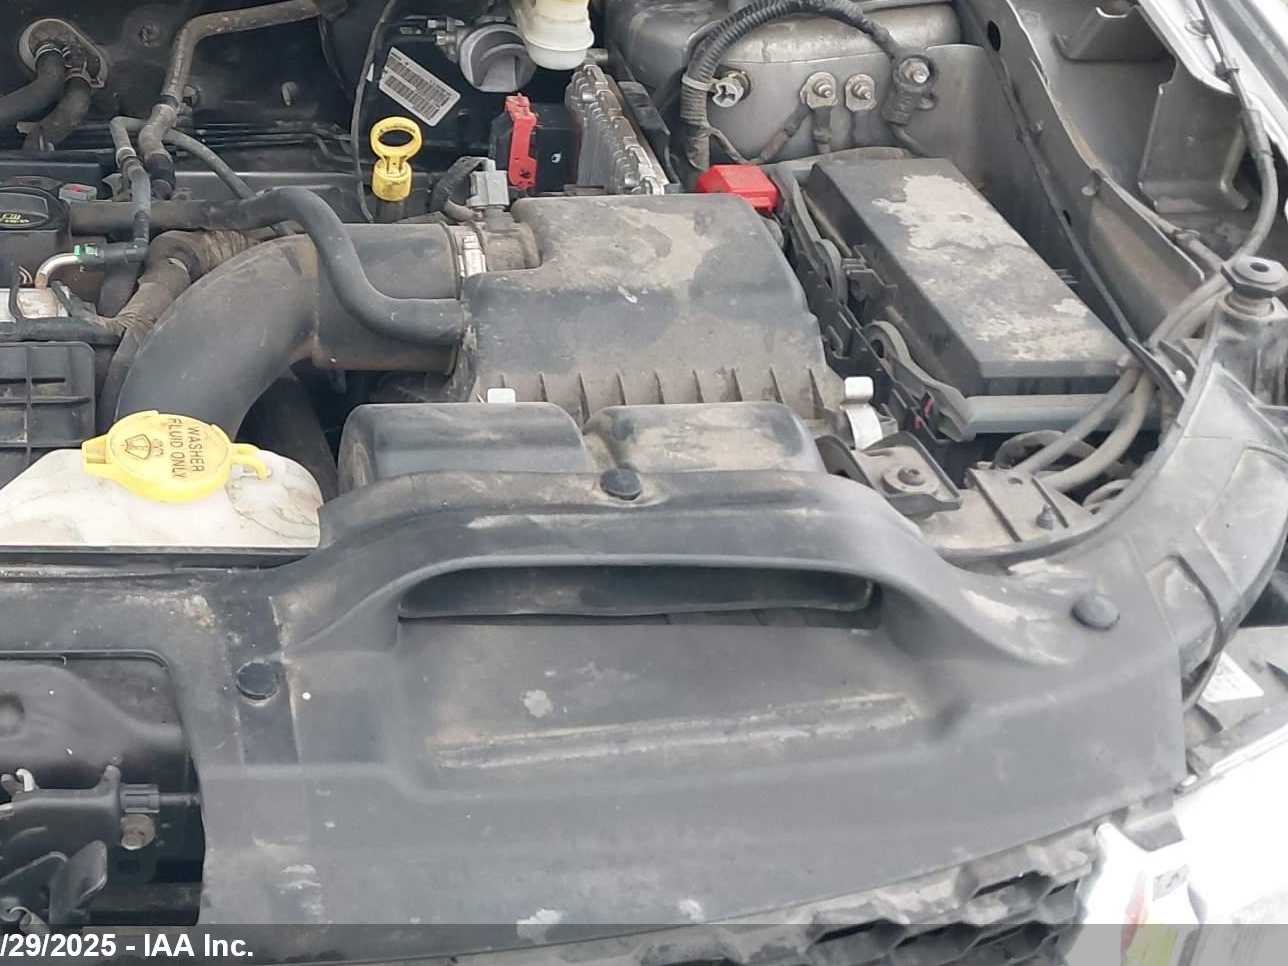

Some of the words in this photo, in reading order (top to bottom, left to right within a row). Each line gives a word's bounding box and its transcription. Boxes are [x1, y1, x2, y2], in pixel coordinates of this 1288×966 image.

[168, 417, 184, 448] FLUID
[171, 451, 186, 478] ONLY
[187, 426, 205, 472] WASHER
